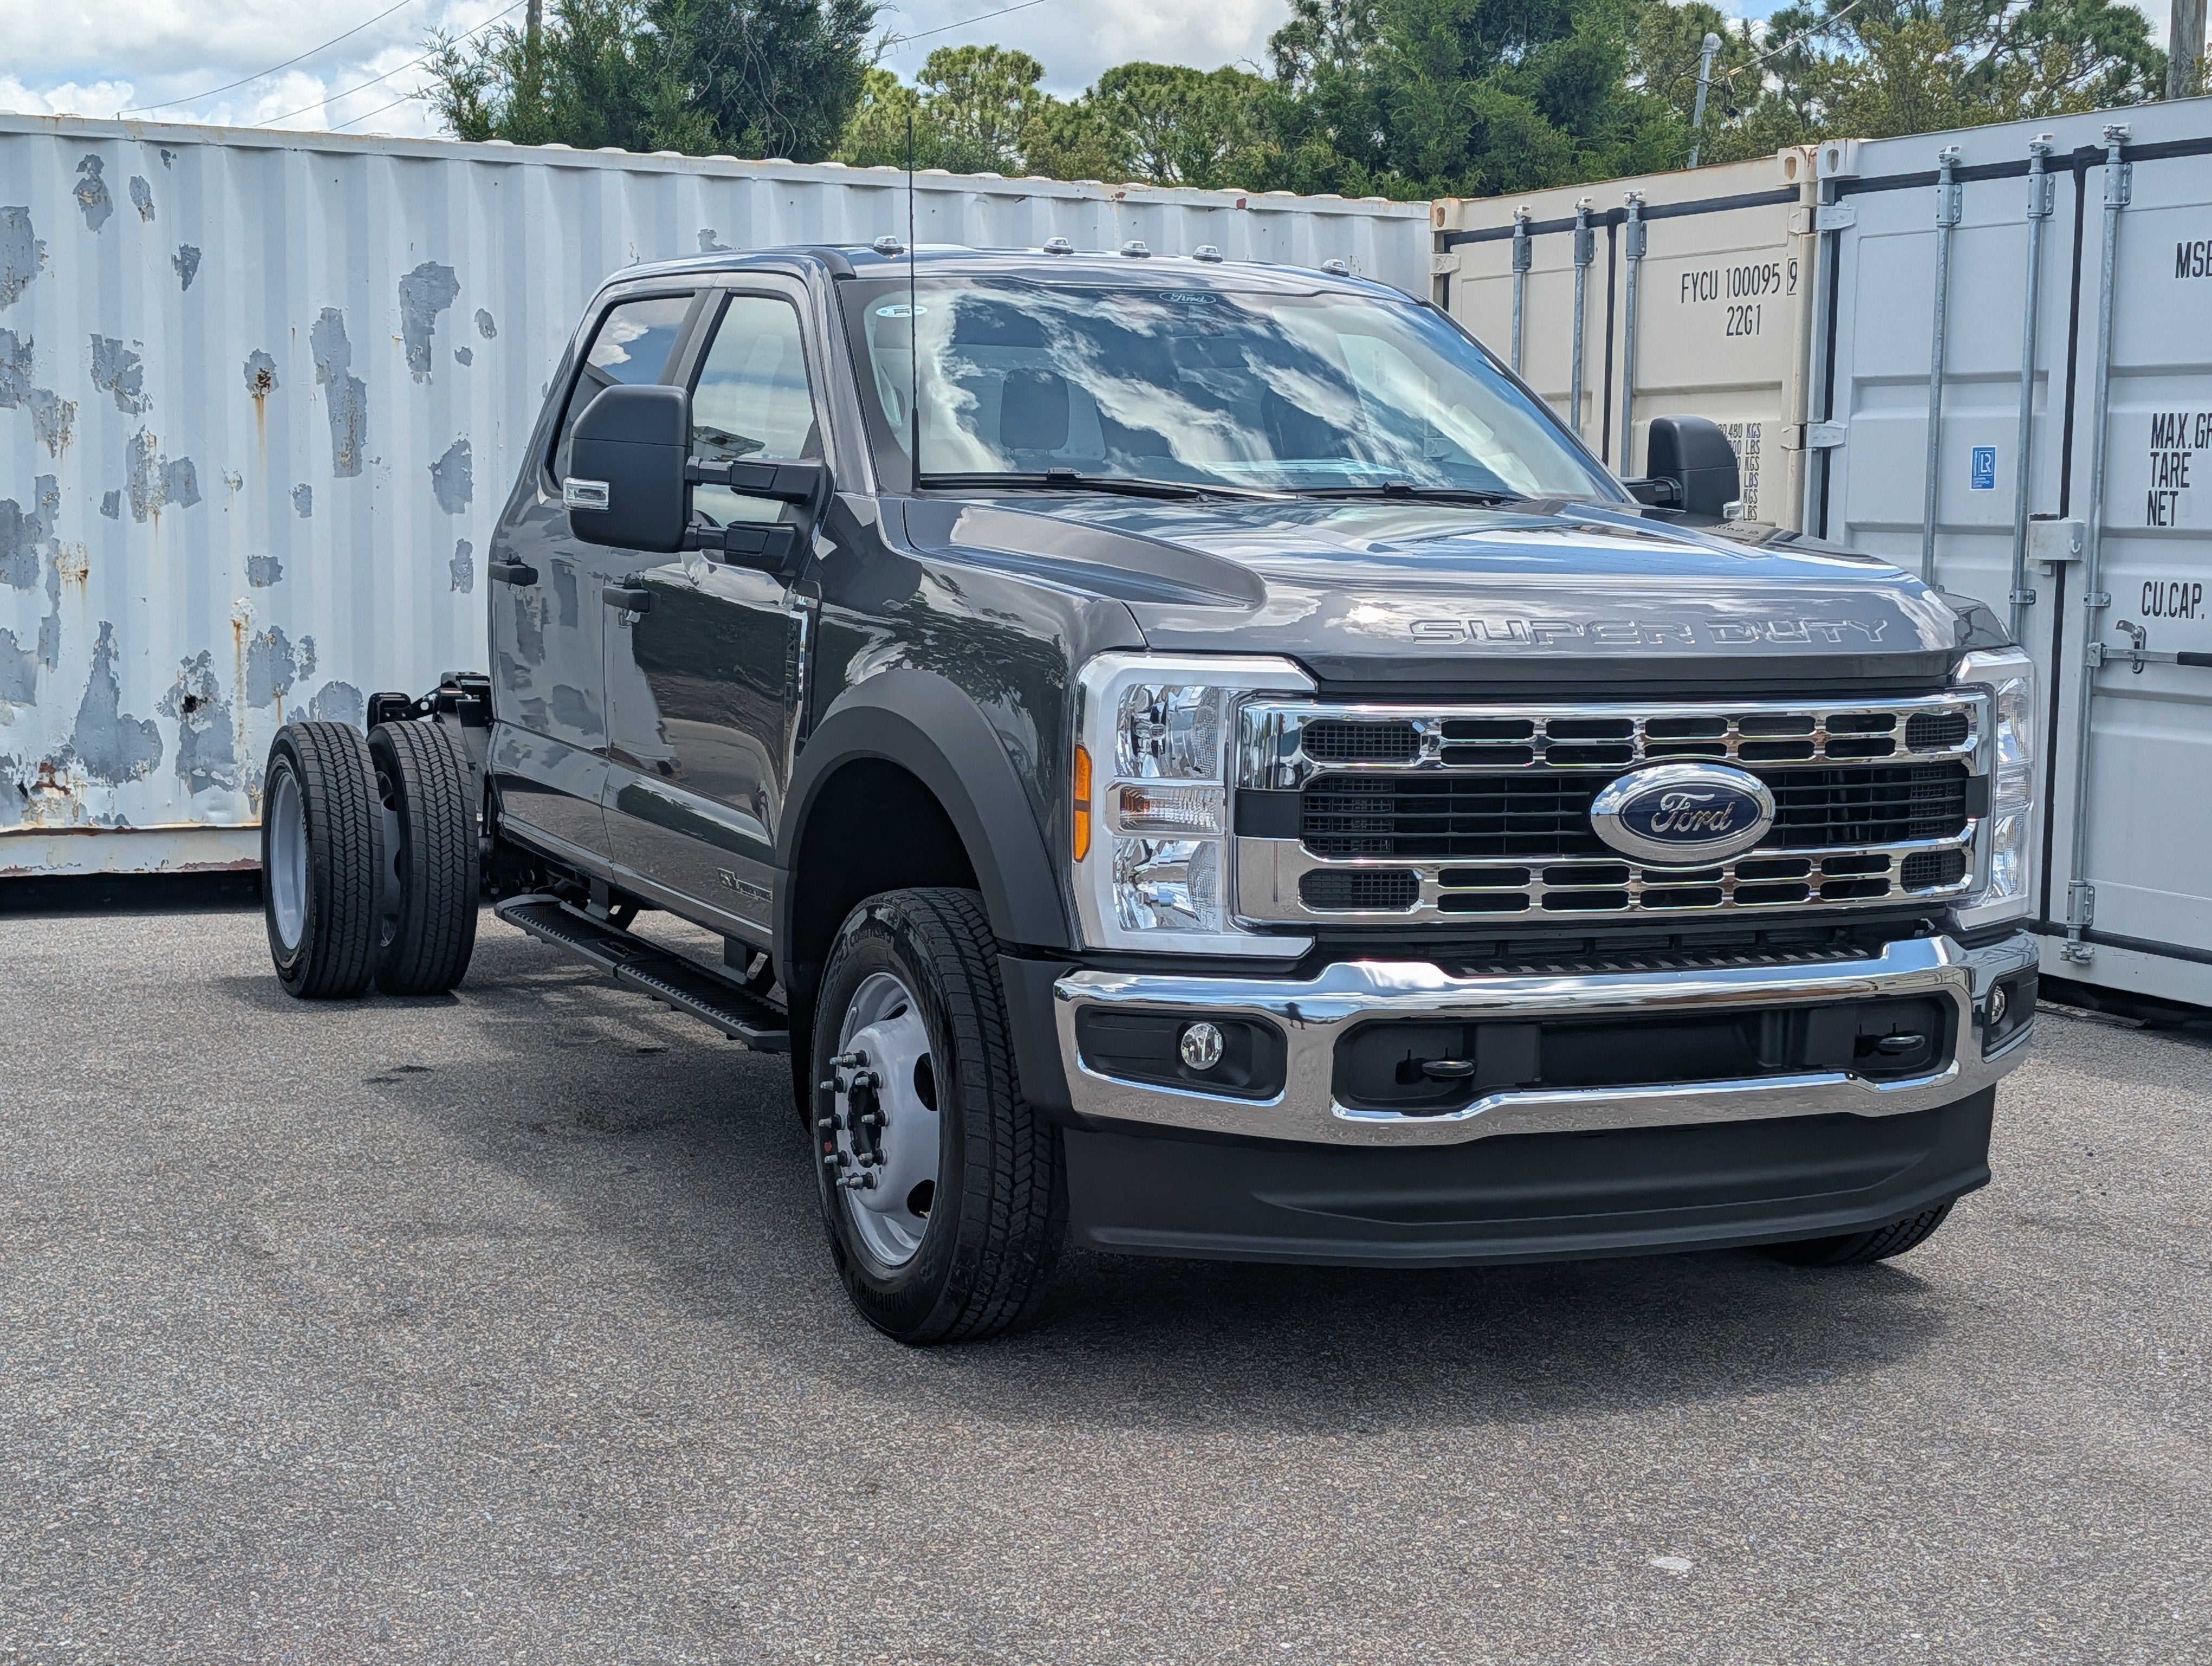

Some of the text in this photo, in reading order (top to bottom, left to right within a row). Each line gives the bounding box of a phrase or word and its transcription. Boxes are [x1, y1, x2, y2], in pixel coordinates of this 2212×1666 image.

[1681, 261, 1798, 304] FYCU 100095 9
[1726, 304, 1761, 336] 22G1
[1746, 422, 1761, 438] KGS
[1745, 439, 1760, 454] LBS
[1744, 456, 1760, 471] KGS
[2150, 452, 2192, 488] TARE
[1743, 489, 1758, 504] KGS
[2146, 490, 2179, 527] NET
[1742, 505, 1758, 521] LBS
[2142, 581, 2205, 620] CU.CAP.
[1409, 619, 1888, 645] SUPER DUTY
[1650, 792, 1736, 832] Ford
